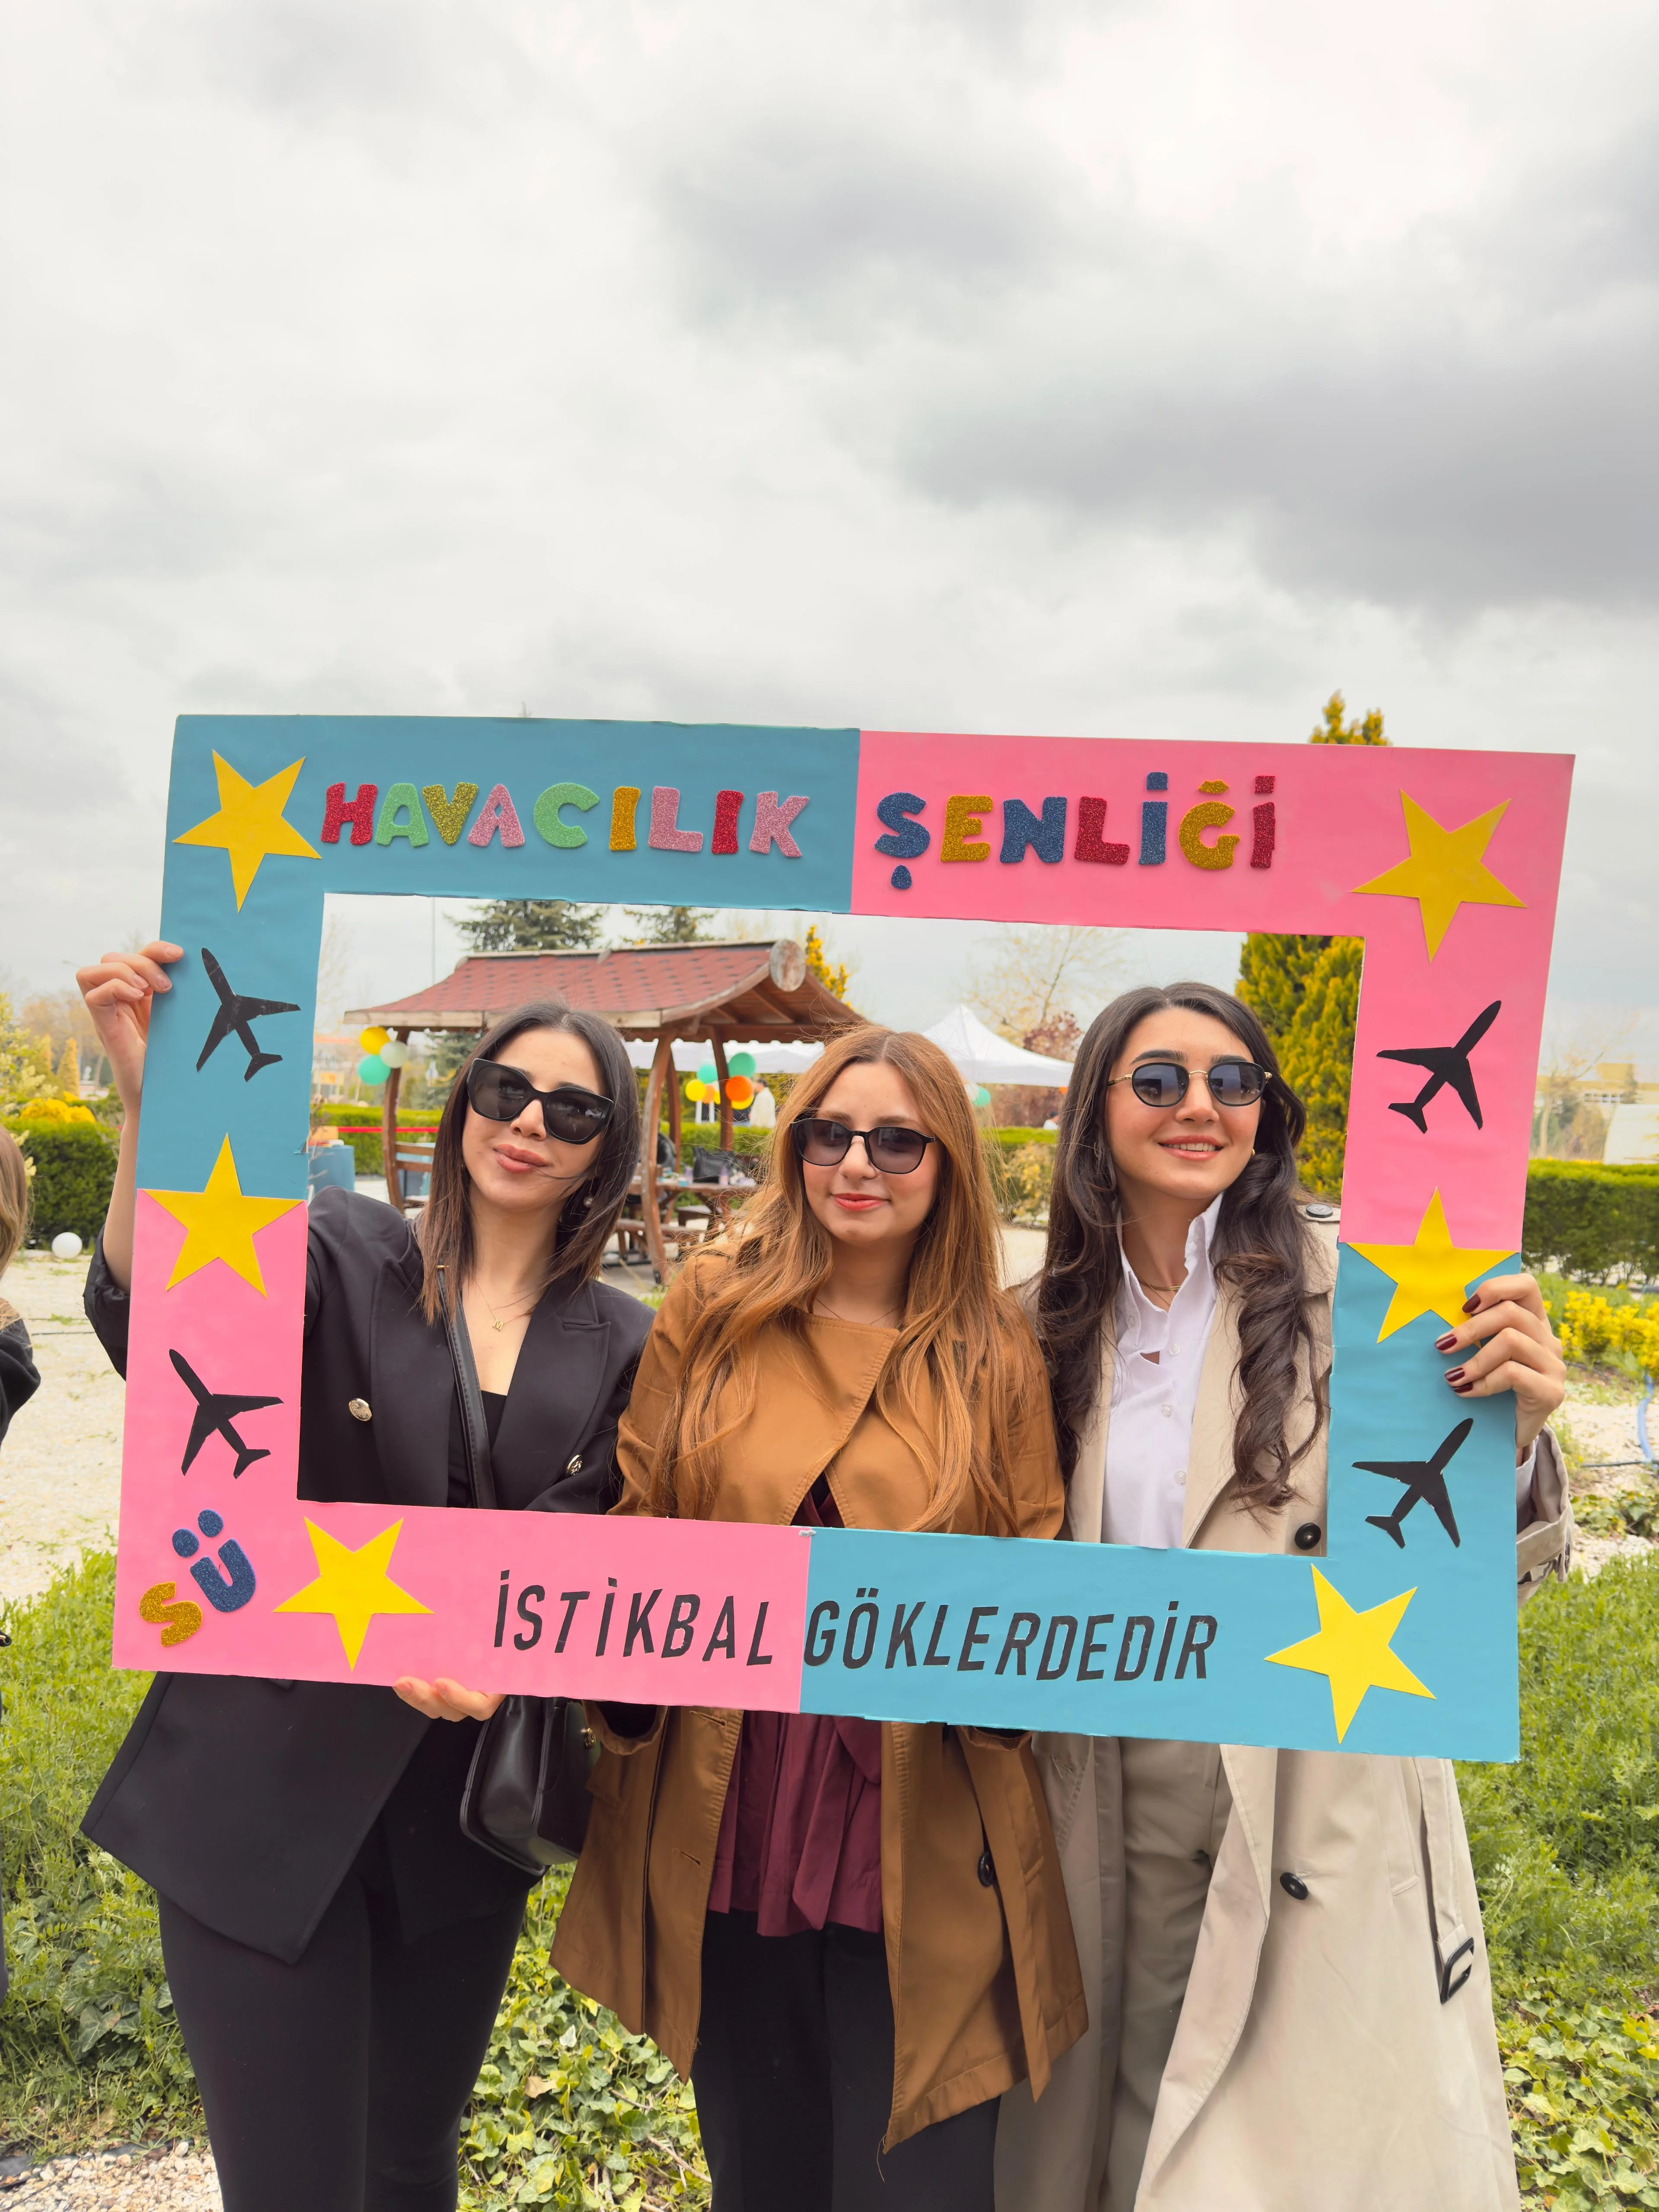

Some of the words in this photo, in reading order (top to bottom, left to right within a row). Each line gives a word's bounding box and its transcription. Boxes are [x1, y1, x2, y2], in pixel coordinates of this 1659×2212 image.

[320, 782, 810, 858] HAVACILIK
[873, 772, 1275, 890] ŞENLİĞİ
[139, 1509, 256, 1647] SÜ
[493, 1569, 773, 1666] İSTİKBAL
[803, 1587, 1218, 1682] GÖKLERDEDİR
